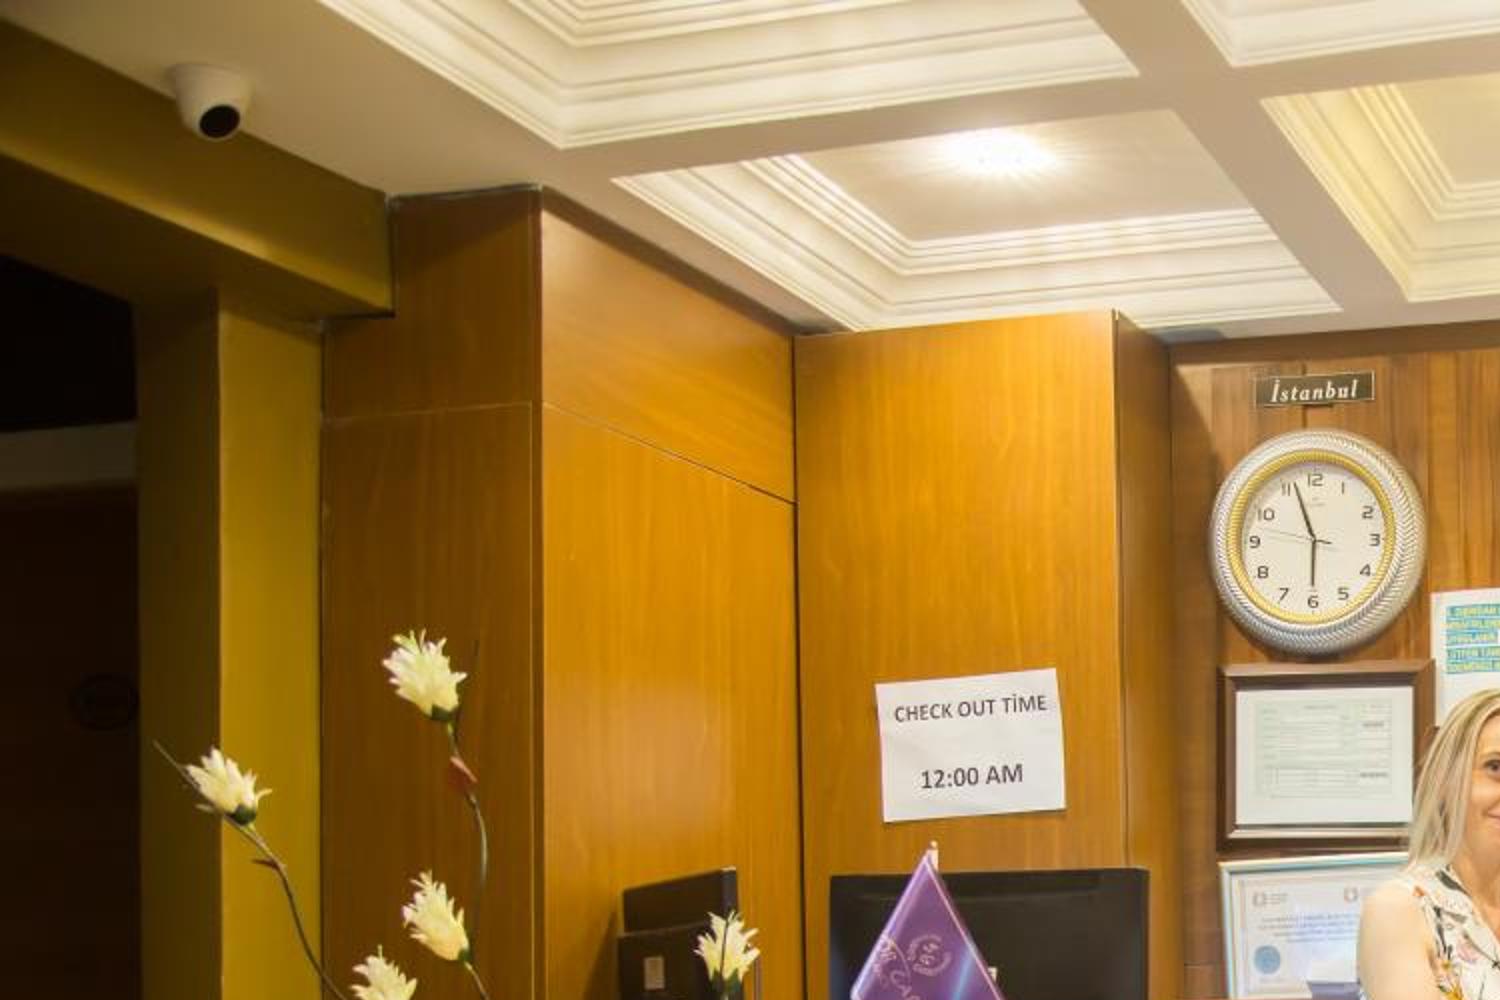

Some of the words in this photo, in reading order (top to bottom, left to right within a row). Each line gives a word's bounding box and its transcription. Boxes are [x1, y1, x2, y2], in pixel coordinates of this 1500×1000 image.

[1308, 474, 1323, 486] 12
[1258, 509, 1274, 520] 10
[1362, 506, 1373, 519] 2
[1250, 536, 1260, 548] 9
[1370, 534, 1380, 546] 3
[1258, 566, 1269, 578] 8
[1360, 564, 1371, 576] 4
[1279, 588, 1289, 600] 7
[1338, 588, 1349, 600] 5
[1308, 596, 1319, 608] 6
[895, 703, 952, 722] CHECK
[958, 699, 996, 717] OUT
[921, 767, 978, 788] 12:00
[986, 764, 1023, 784] AM
